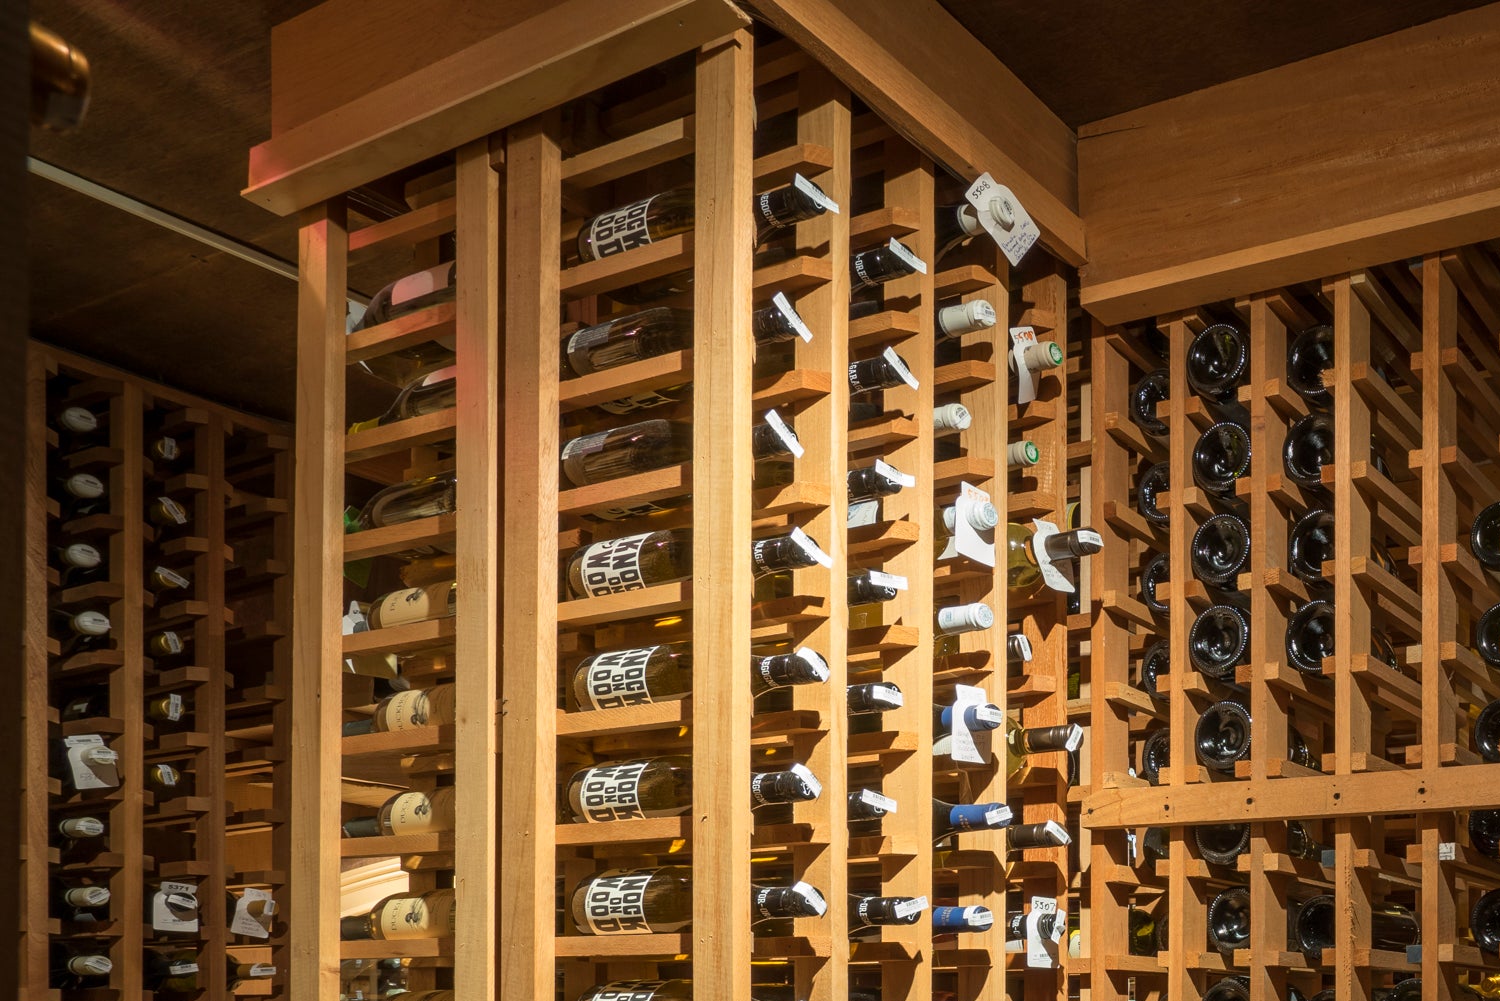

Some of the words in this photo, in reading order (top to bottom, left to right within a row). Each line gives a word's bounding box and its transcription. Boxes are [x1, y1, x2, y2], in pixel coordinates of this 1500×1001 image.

[596, 214, 625, 258] OOD
[622, 200, 652, 251] OCK
[587, 550, 615, 597] WOO
[612, 538, 645, 592] KNOC
[609, 896, 622, 913] ON
